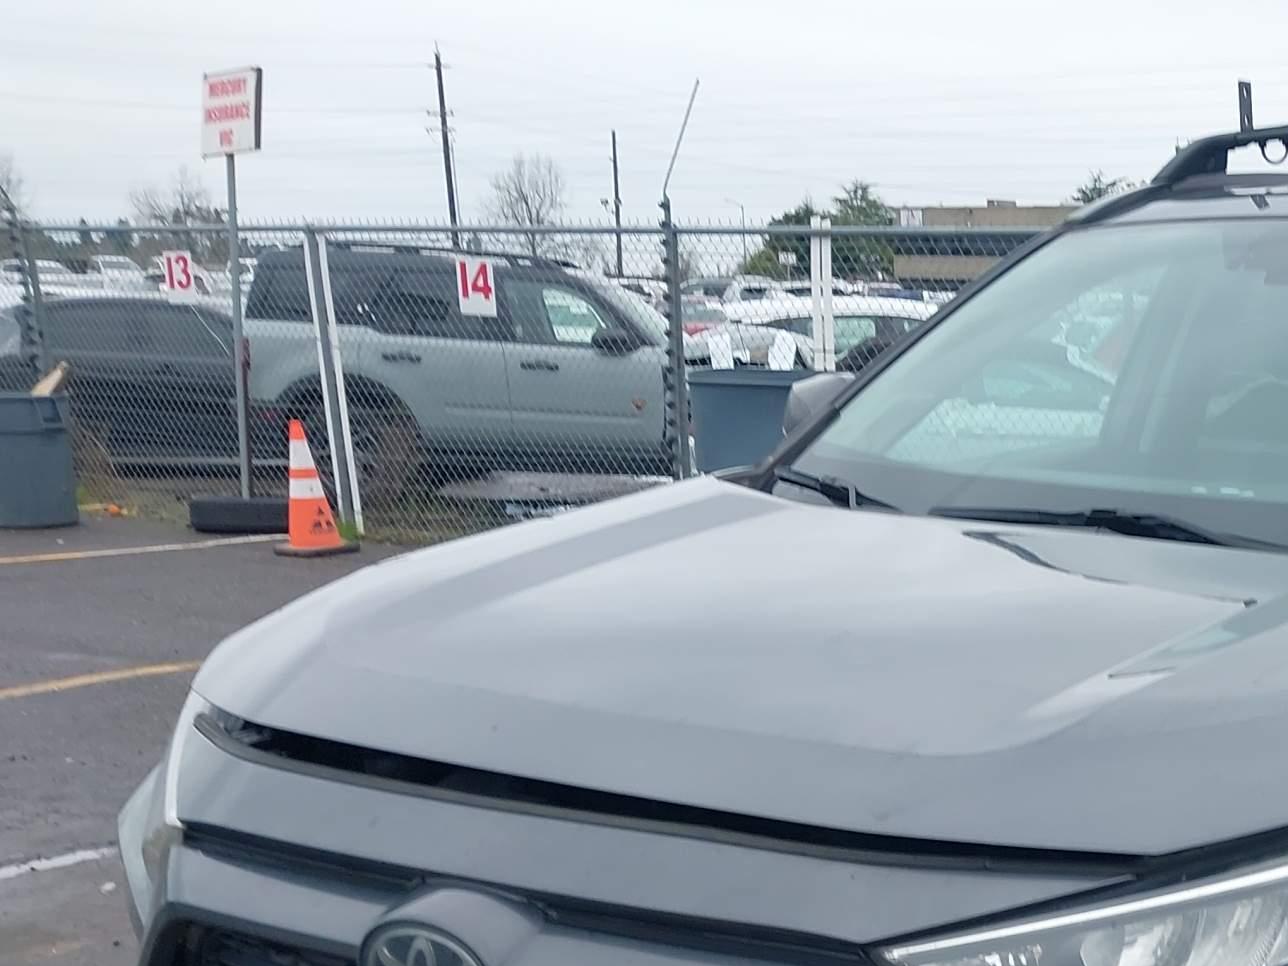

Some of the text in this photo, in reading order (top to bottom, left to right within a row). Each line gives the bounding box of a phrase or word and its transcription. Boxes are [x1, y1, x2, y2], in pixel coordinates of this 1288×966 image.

[208, 78, 247, 98] MERCURY
[205, 102, 250, 124] INSURANCE
[166, 255, 191, 289] 13
[459, 260, 492, 300] 14
